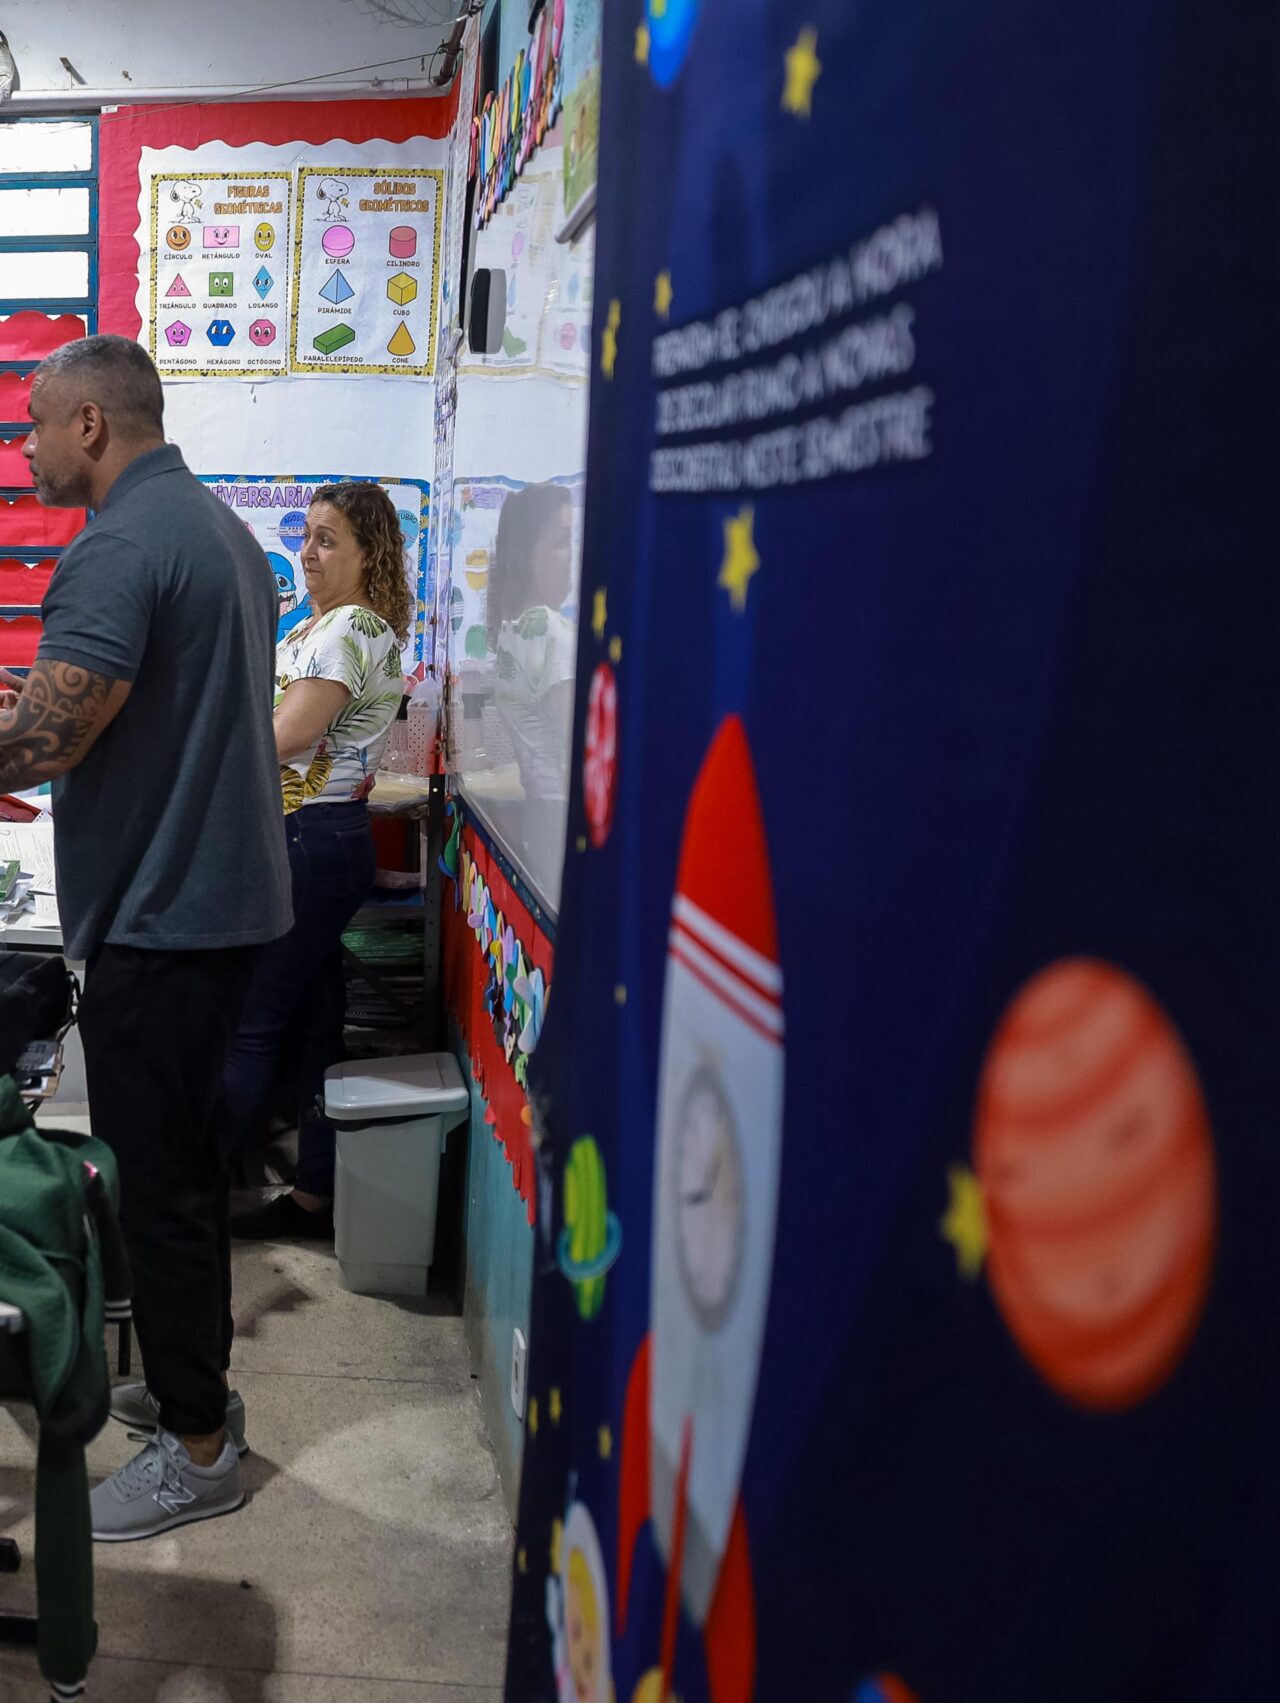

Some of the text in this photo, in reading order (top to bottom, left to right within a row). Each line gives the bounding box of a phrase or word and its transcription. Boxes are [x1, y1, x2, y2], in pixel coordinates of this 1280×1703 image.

[164, 252, 193, 260] CÍRCULO
[160, 357, 197, 365] PENTÁGONO
[207, 357, 241, 365] HEXÁGONO
[247, 357, 281, 365] OCTÓGONO
[304, 354, 364, 363] PARALELEPÍPEDO
